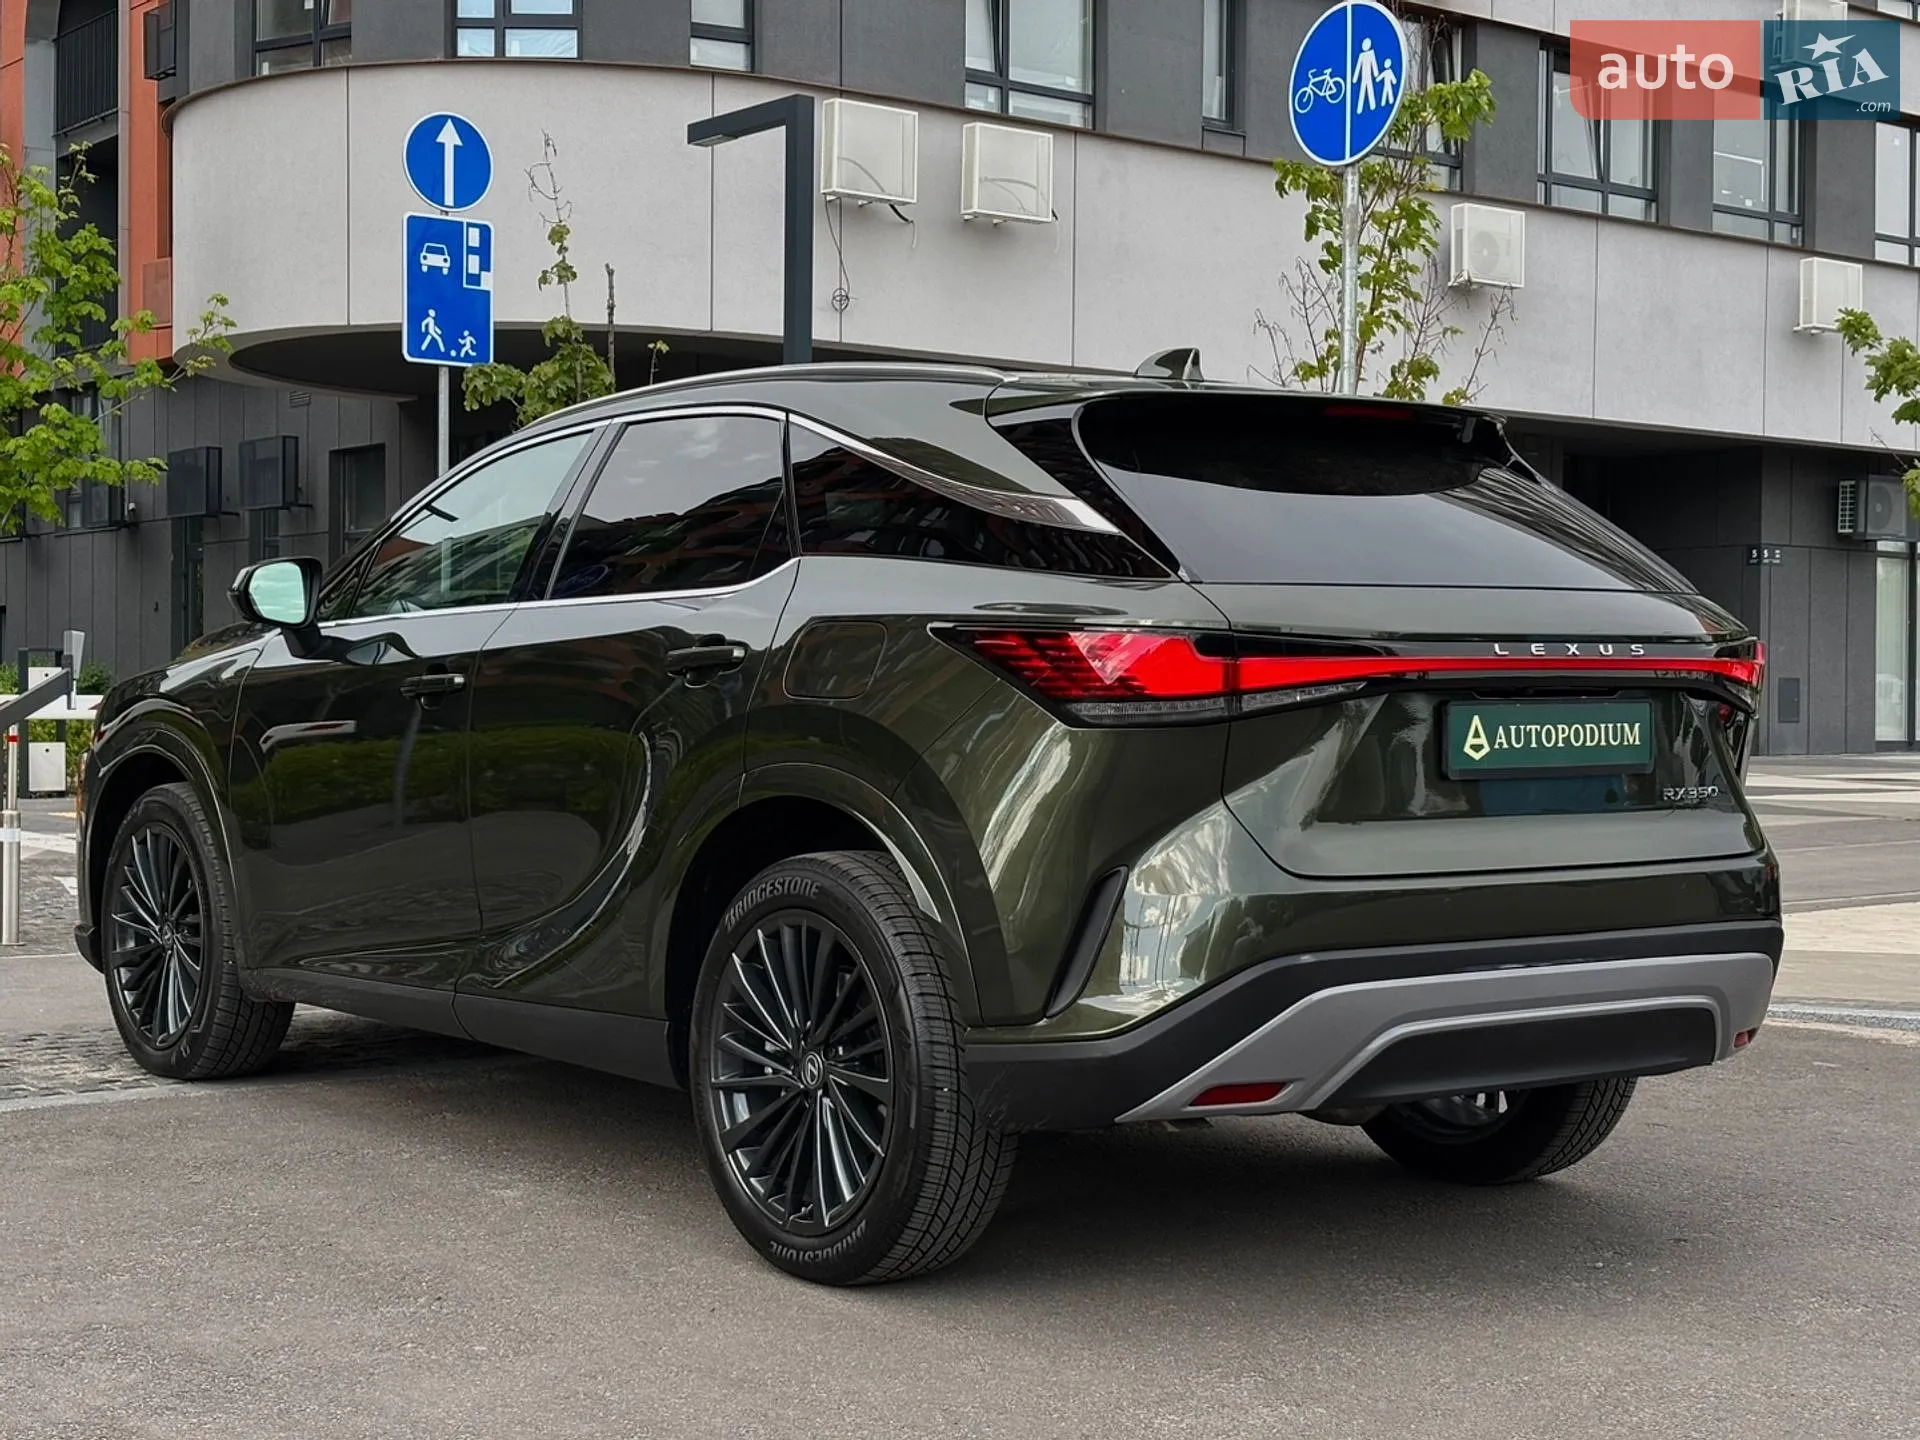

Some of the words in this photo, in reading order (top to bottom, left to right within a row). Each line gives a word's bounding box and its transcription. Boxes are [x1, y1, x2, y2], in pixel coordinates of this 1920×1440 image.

[1494, 644, 1645, 656] LEXUS
[1493, 723, 1641, 749] AUTOPODIUM
[725, 876, 821, 932] BRIDGESTONE
